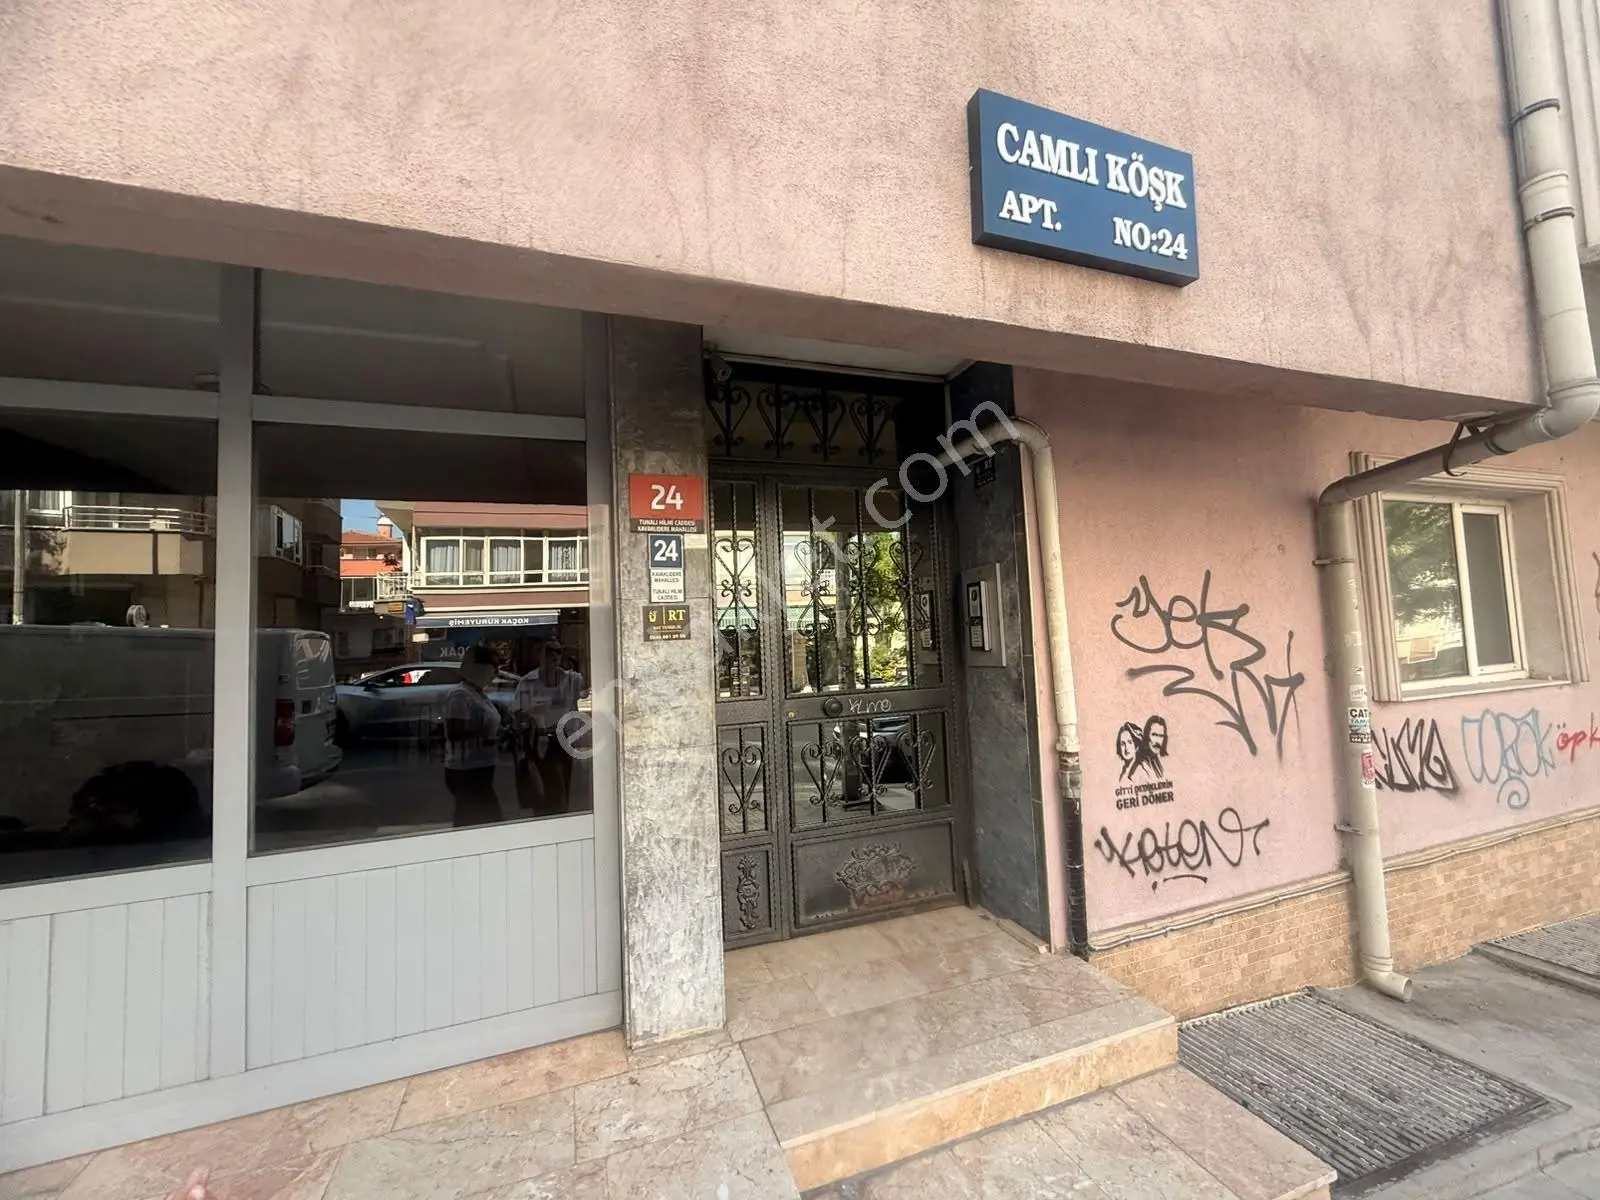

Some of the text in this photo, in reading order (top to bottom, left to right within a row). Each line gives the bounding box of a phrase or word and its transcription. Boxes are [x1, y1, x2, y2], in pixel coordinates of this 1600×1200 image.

[996, 122, 1187, 212] CAMLI KÖŞK
[998, 190, 1188, 260] APT. NO:24
[650, 484, 684, 510] 24
[653, 539, 679, 561] 24
[667, 609, 686, 621] RT
[1116, 791, 1174, 810] GERİ DÖNER
